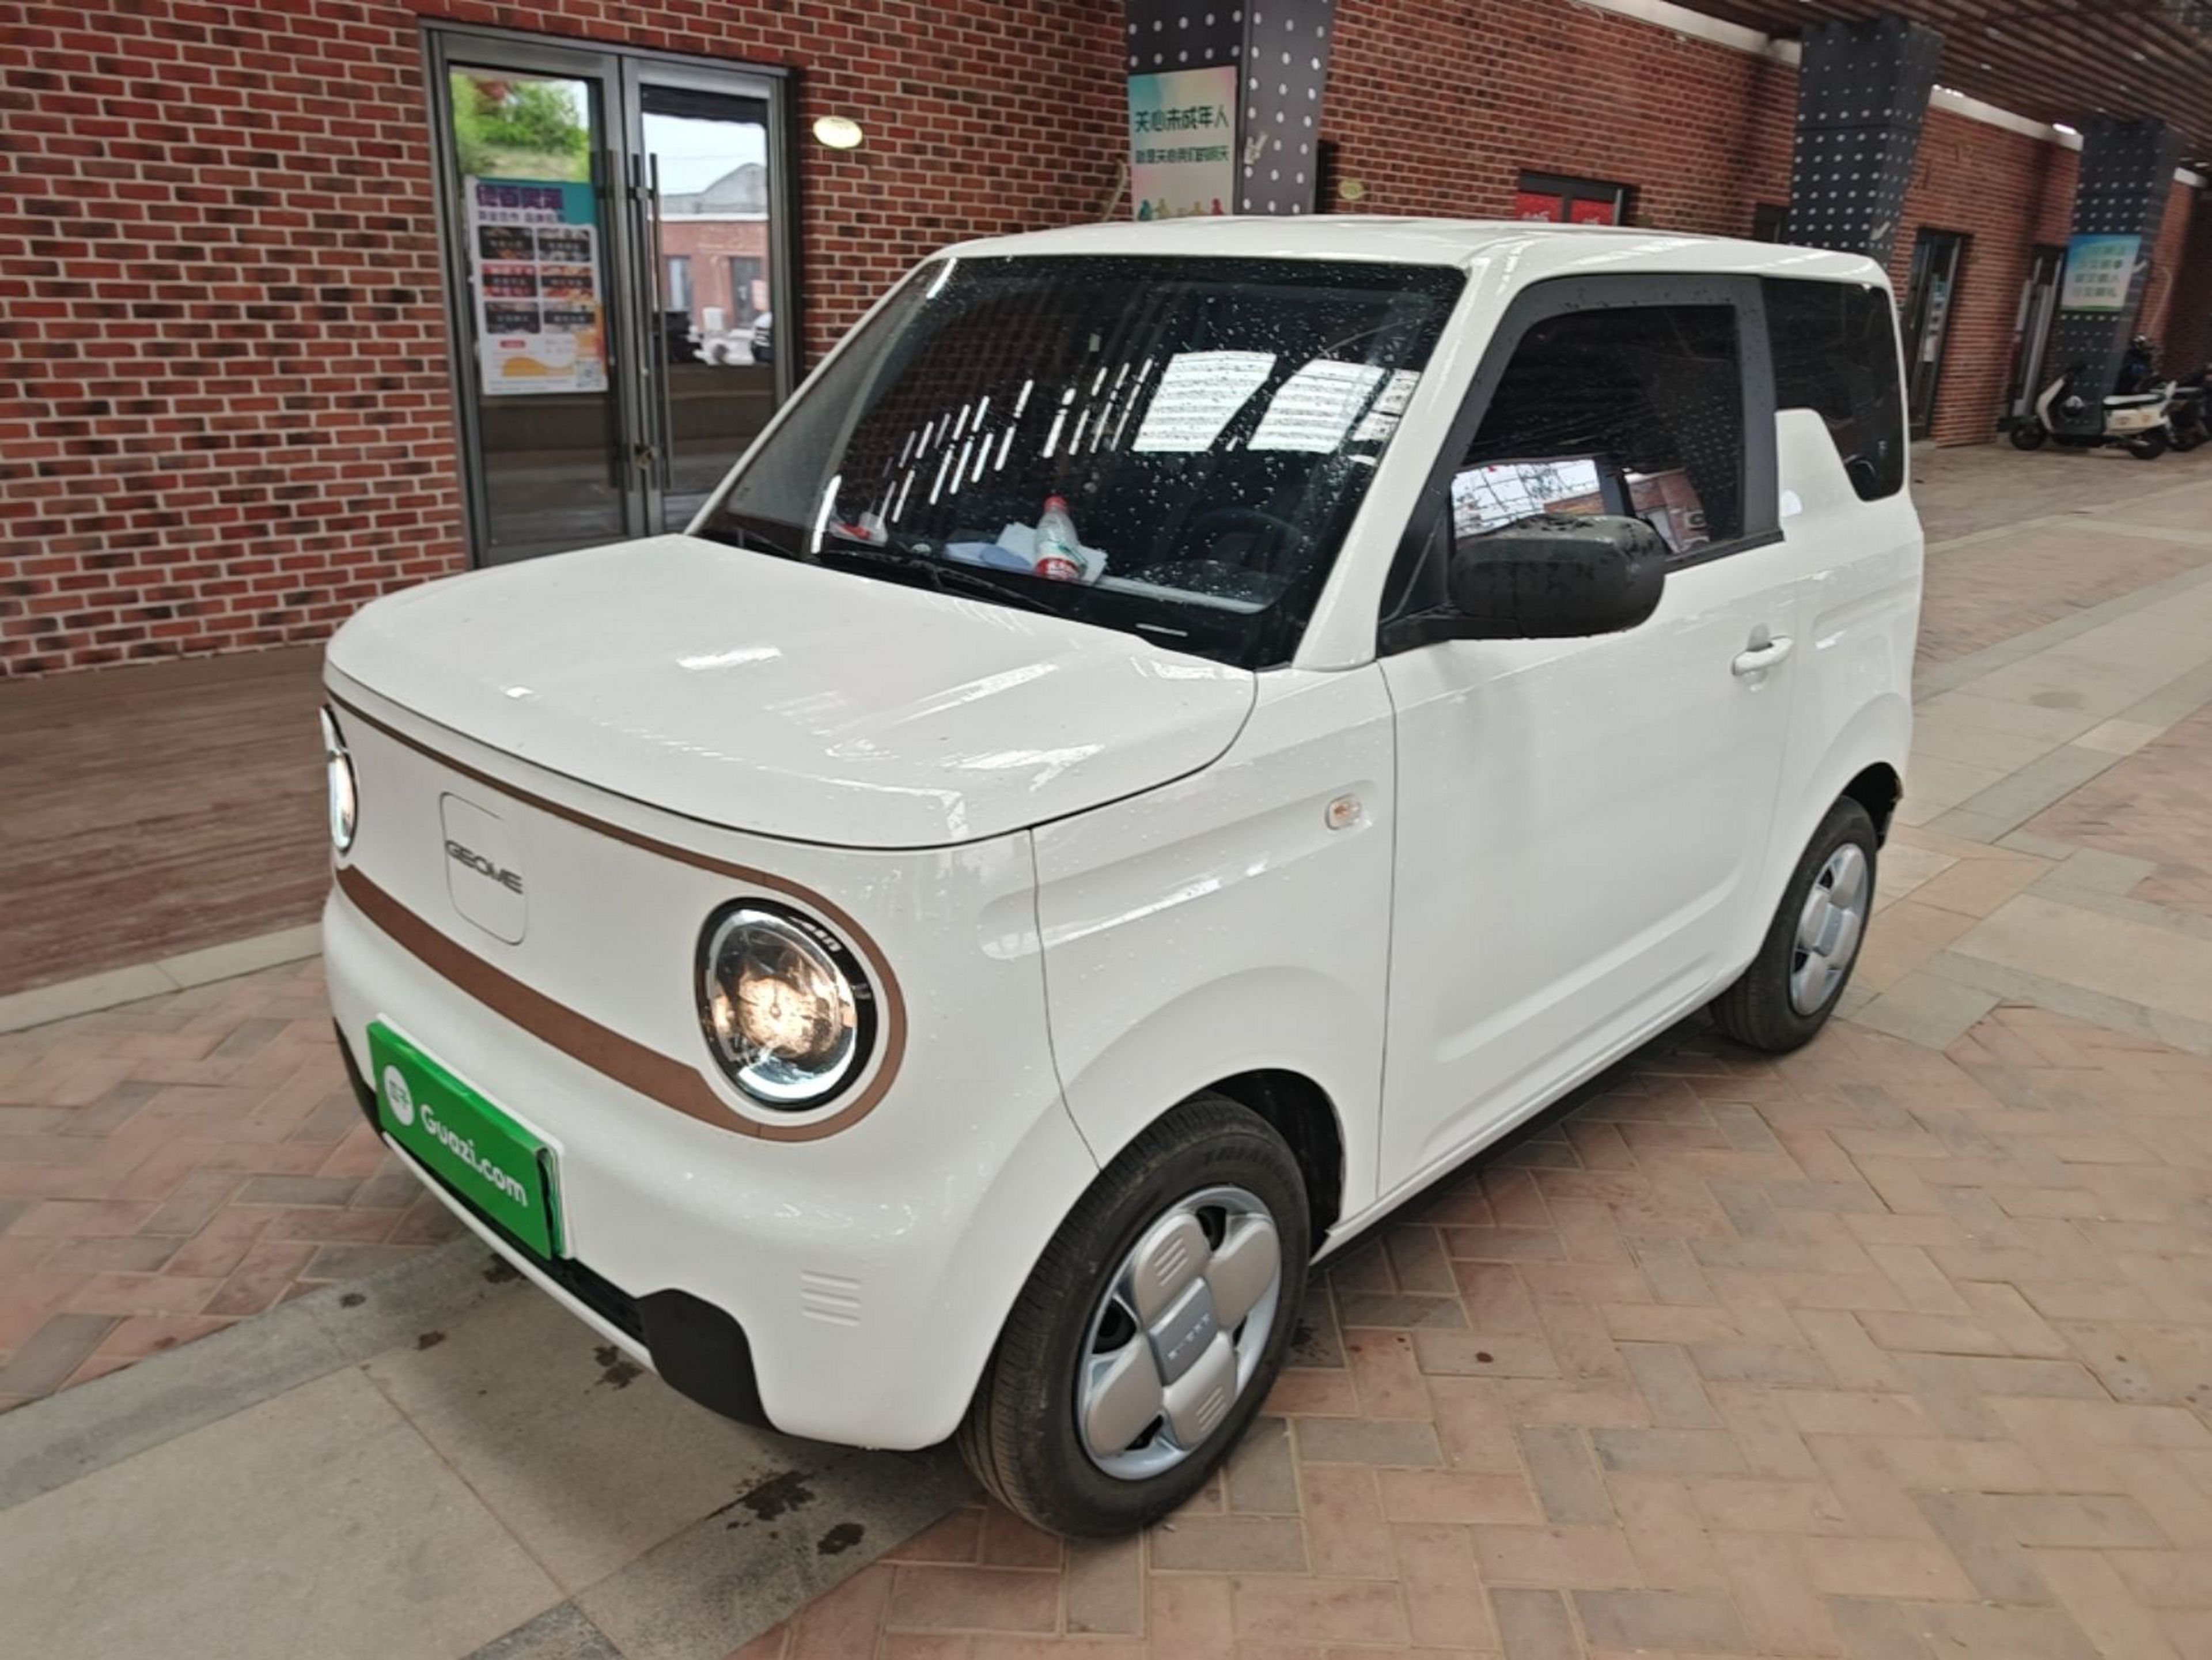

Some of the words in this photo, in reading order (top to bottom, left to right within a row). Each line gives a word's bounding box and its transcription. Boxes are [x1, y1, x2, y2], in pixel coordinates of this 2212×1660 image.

[1135, 104, 1228, 133] 关心未成年人
[445, 840, 524, 895] GEOME
[420, 1103, 528, 1207] Guazi.com
